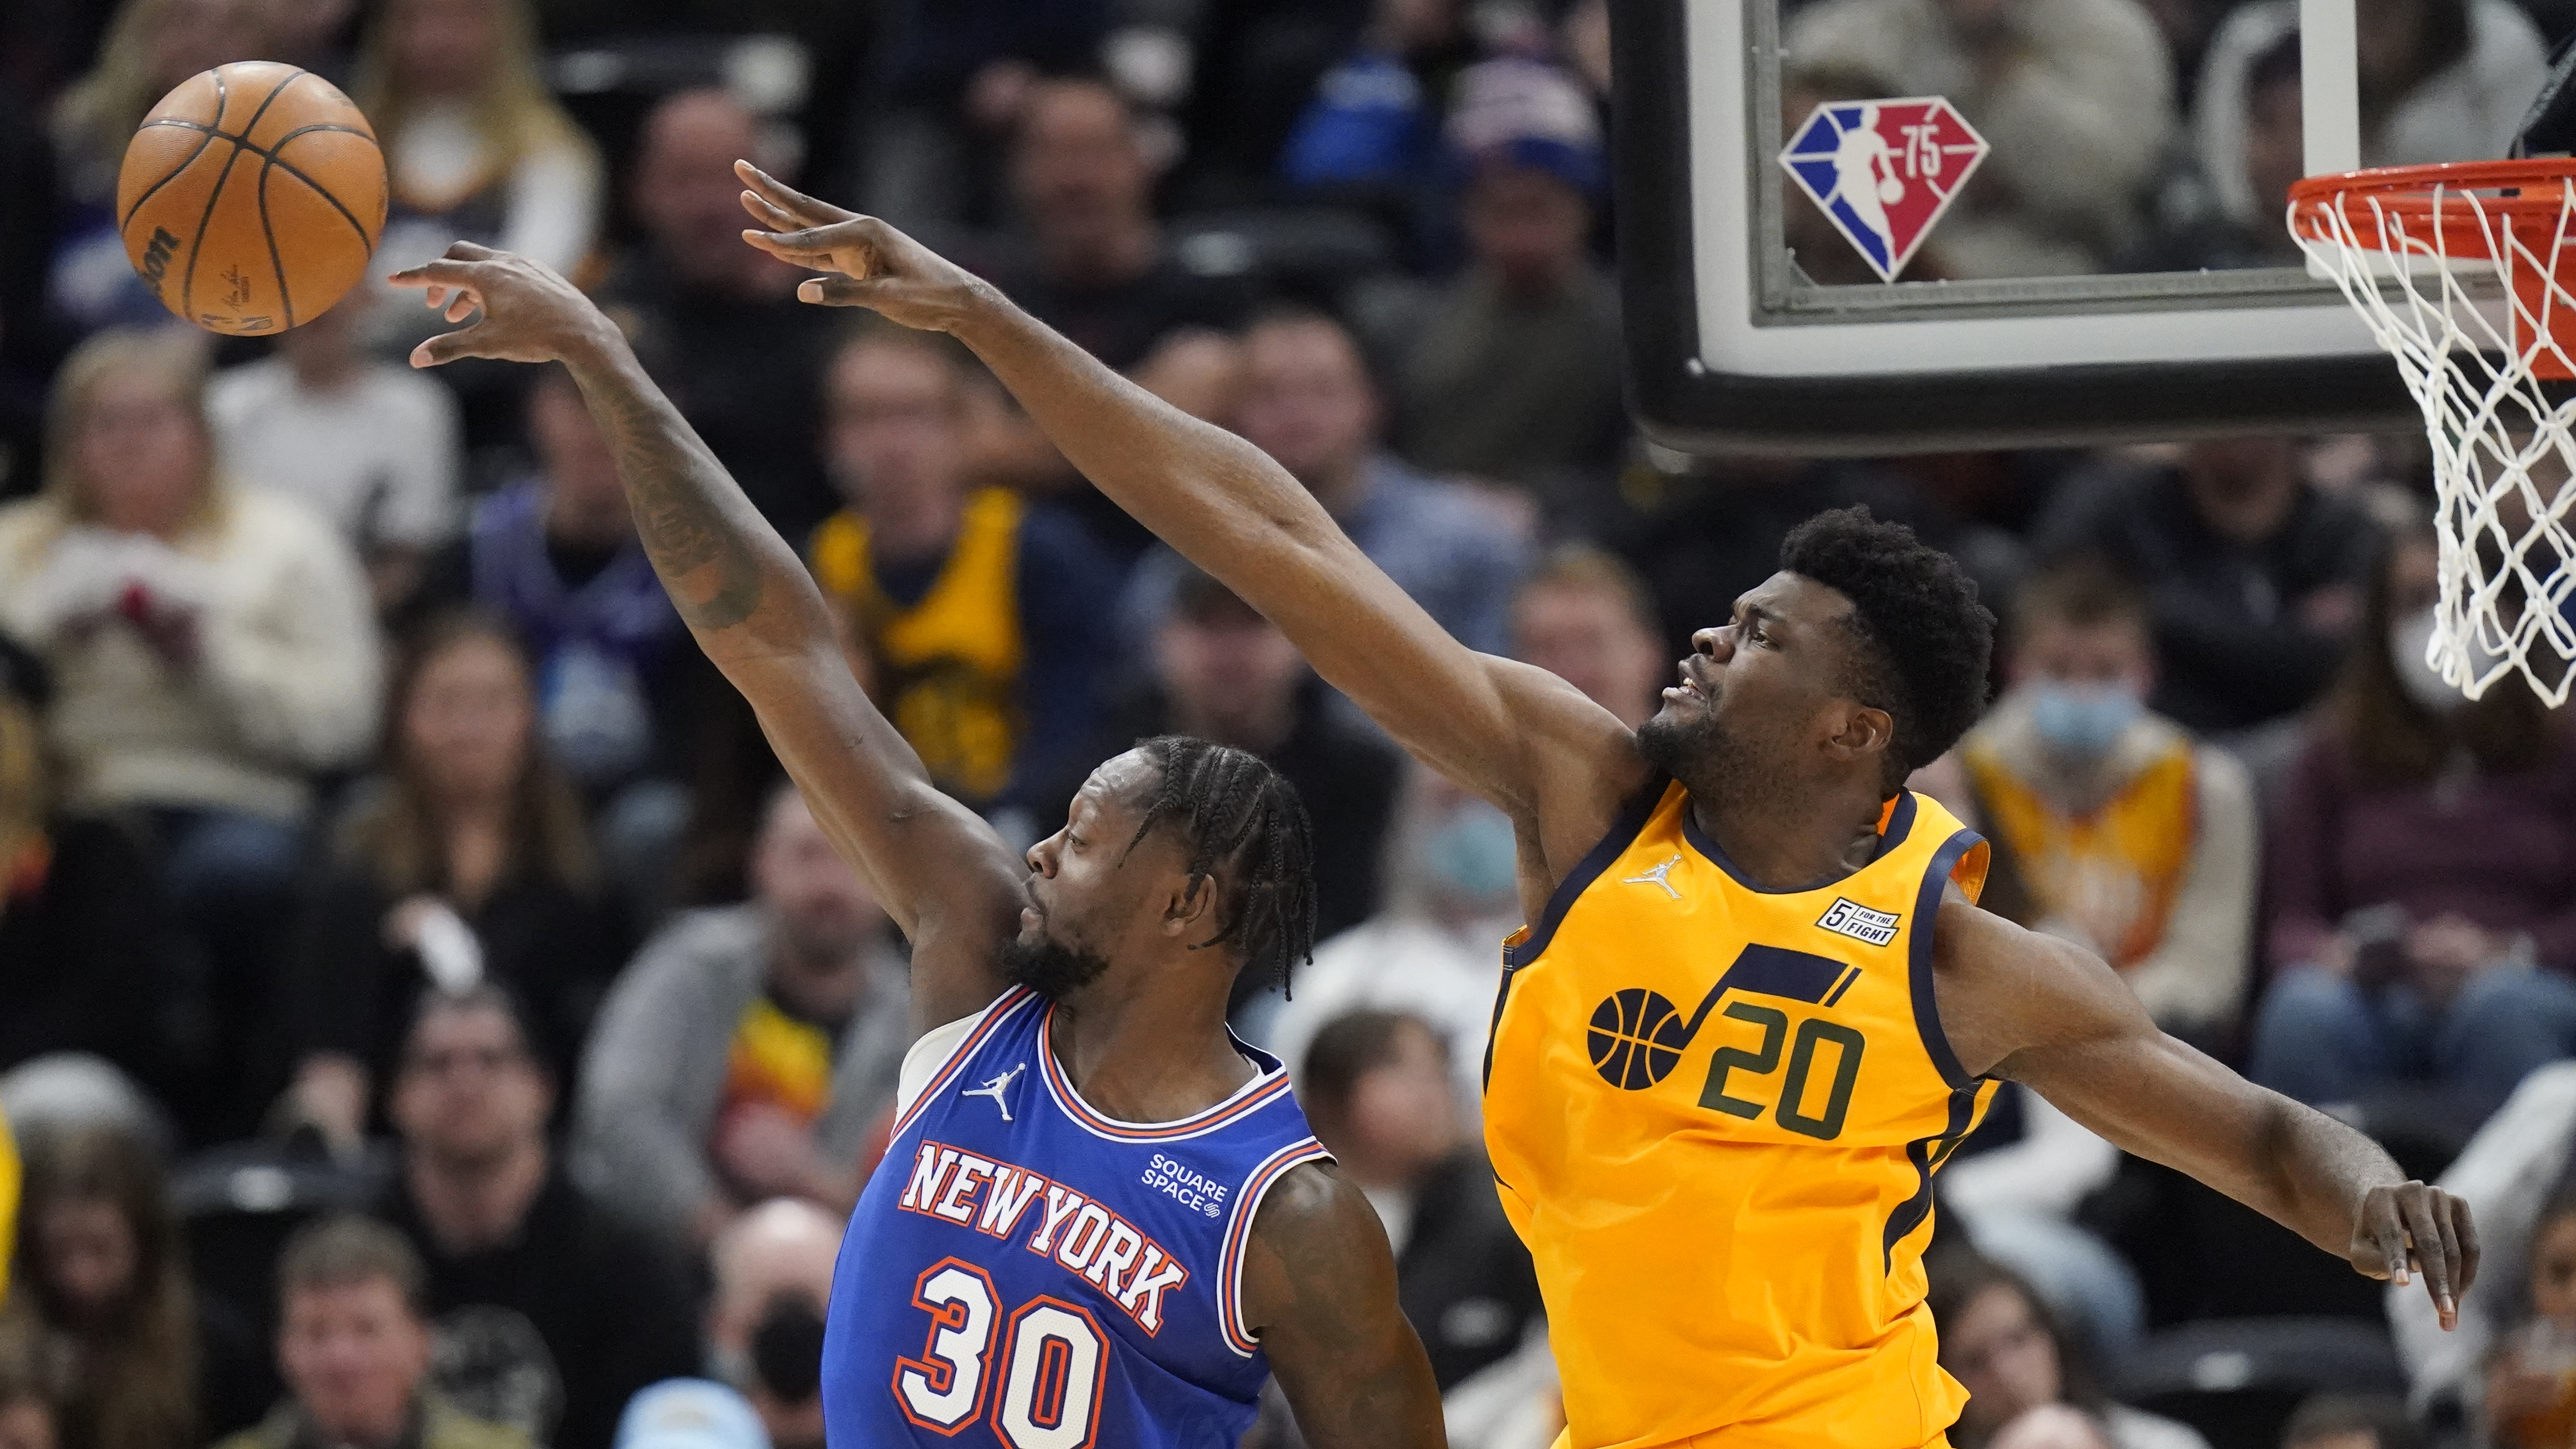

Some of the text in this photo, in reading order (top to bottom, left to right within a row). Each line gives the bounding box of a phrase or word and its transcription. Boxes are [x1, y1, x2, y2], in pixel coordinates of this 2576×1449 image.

[1901, 125, 1941, 177] 75
[1826, 903, 1853, 927] 5
[1846, 922, 1890, 941] FIGHT
[1859, 911, 1893, 924] FOR THE
[1697, 1001, 1865, 1141] 20
[1142, 1169, 1205, 1211] SPACE
[1150, 1154, 1227, 1202] SQUARE
[898, 1139, 1189, 1338] NEW YORK
[892, 1256, 1111, 1449] 30
